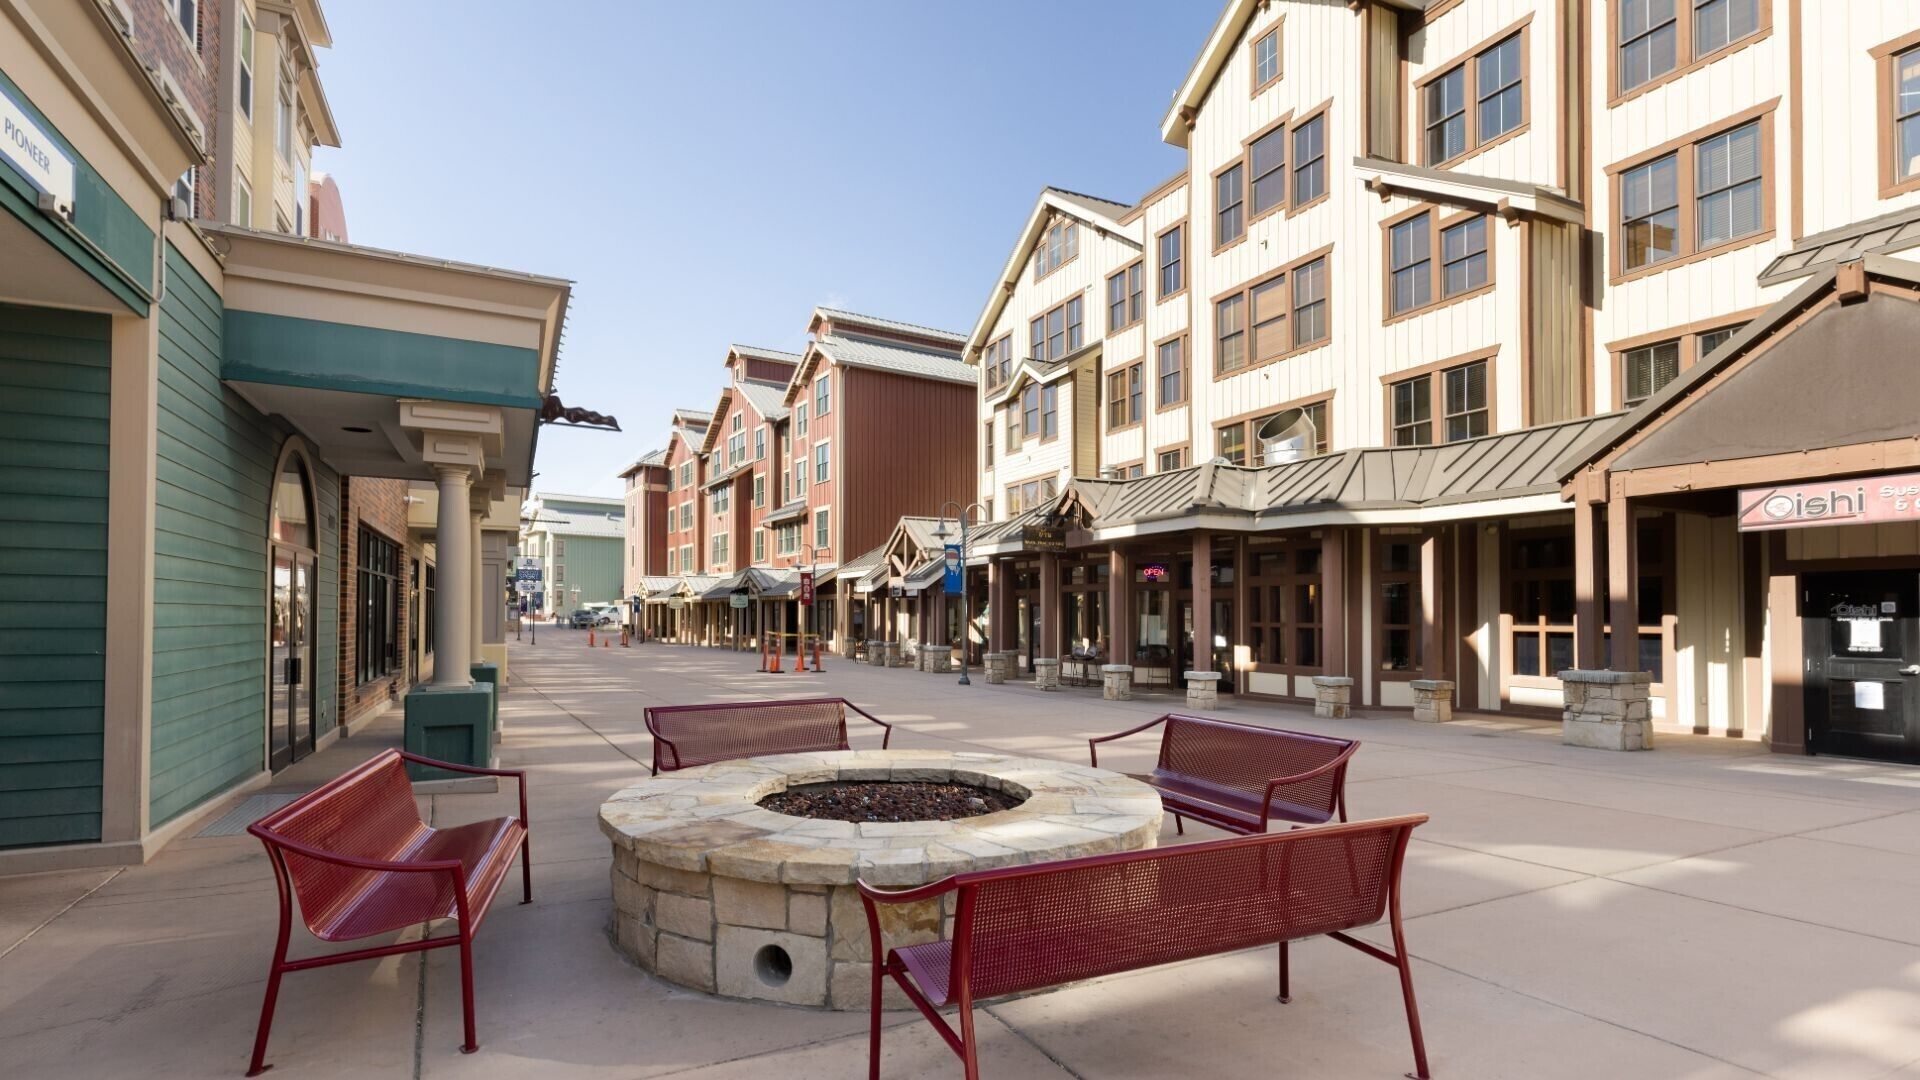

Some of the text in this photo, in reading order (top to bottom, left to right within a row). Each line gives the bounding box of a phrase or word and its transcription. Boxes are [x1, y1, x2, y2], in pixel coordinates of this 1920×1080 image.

[4, 117, 50, 175] PIONEER
[1763, 487, 1865, 520] Oishi
[1143, 568, 1164, 576] OPEN
